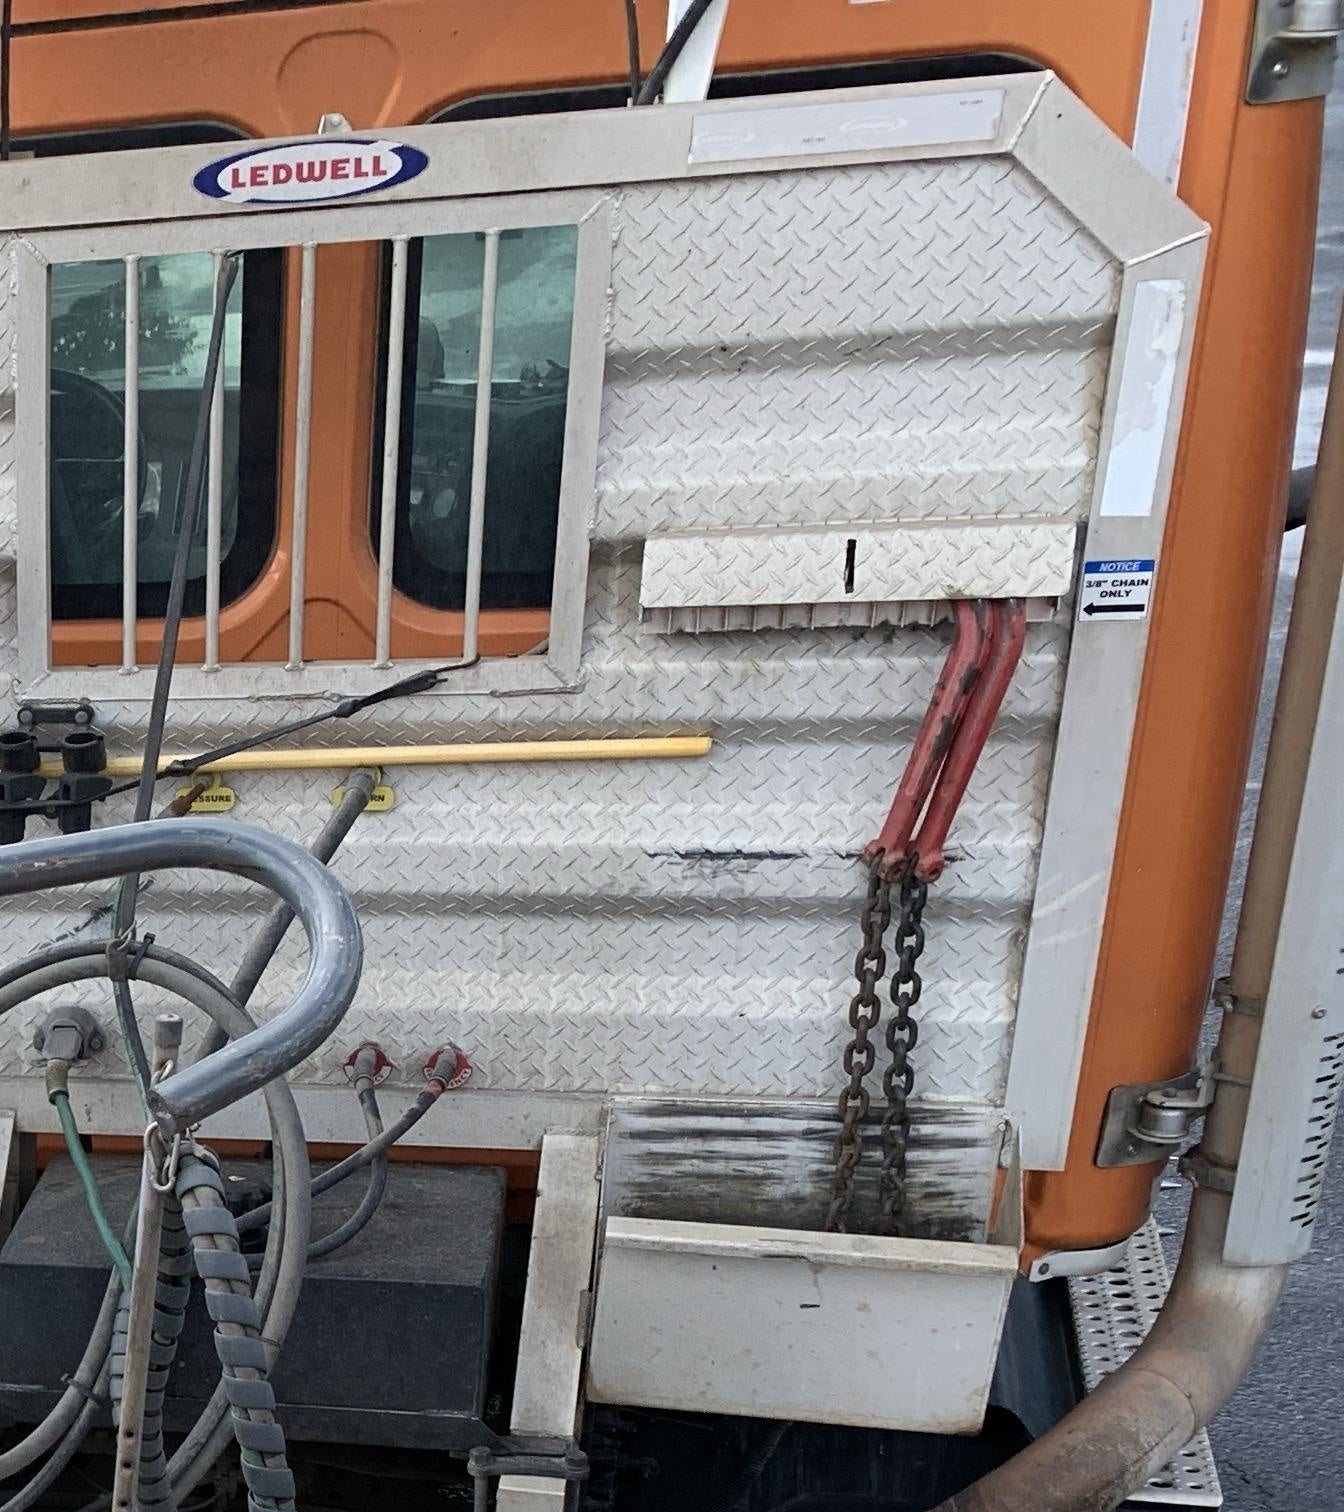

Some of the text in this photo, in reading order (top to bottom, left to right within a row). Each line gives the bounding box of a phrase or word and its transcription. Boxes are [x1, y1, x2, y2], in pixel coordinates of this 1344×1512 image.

[230, 155, 388, 189] LEDWELL
[1099, 562, 1141, 572] NOTICE
[1111, 578, 1149, 588] CHAIN
[1100, 590, 1132, 598] ONLY
